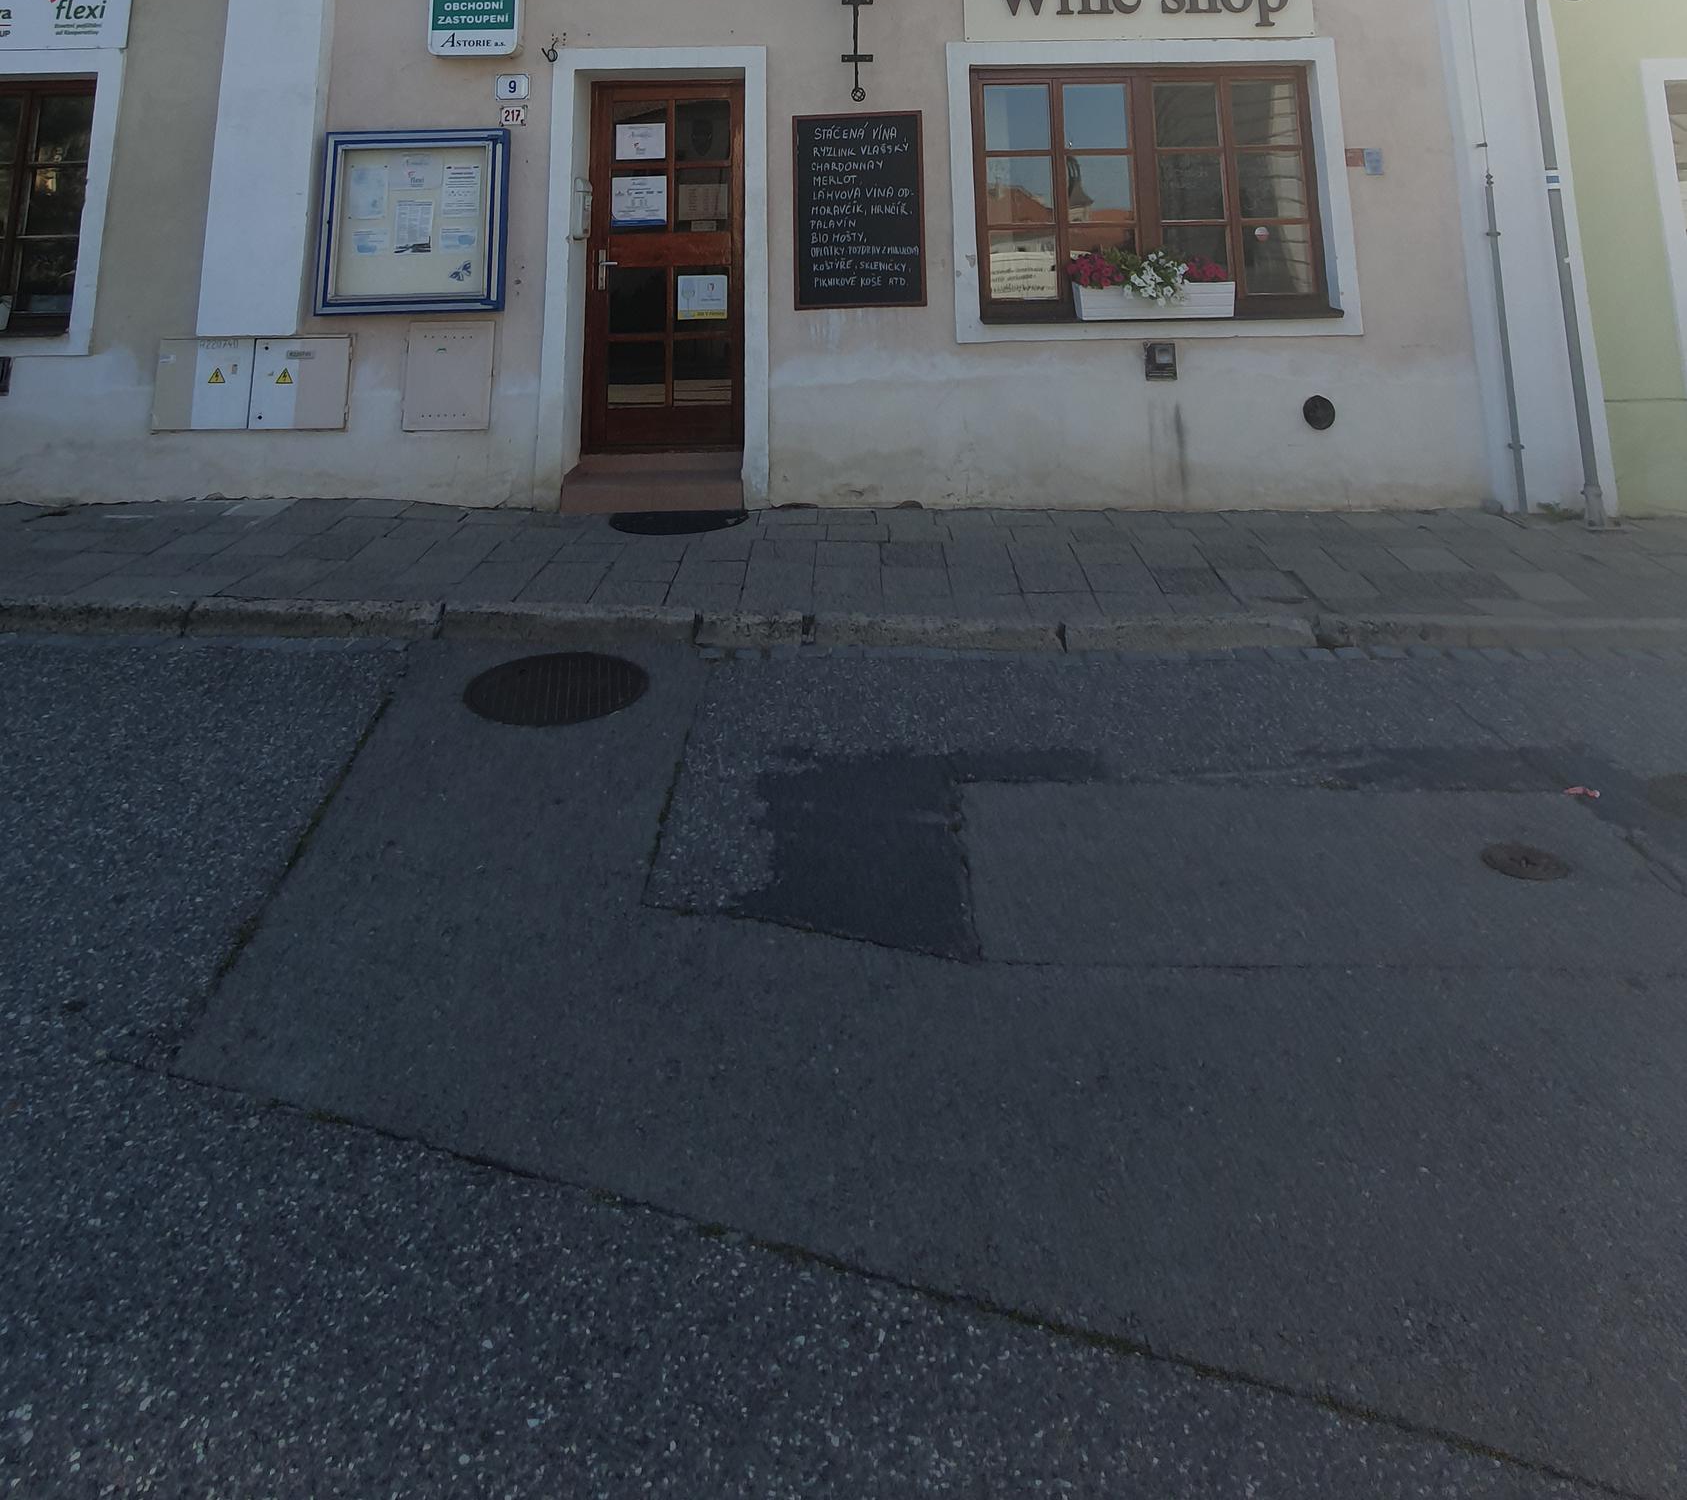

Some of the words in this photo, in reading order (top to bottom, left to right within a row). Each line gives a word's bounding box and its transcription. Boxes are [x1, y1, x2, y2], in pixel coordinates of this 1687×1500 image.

[56, 0, 107, 20] flexi
[444, 0, 504, 11] OBCHODNÍ
[438, 13, 509, 24] ZASTOUPENÍ
[508, 80, 517, 93] 9
[504, 109, 521, 122] 217
[872, 124, 897, 141] VÍNA
[813, 146, 857, 158] RYZLINK
[811, 160, 884, 172] CHARDONNAY
[811, 232, 829, 244] BIO
